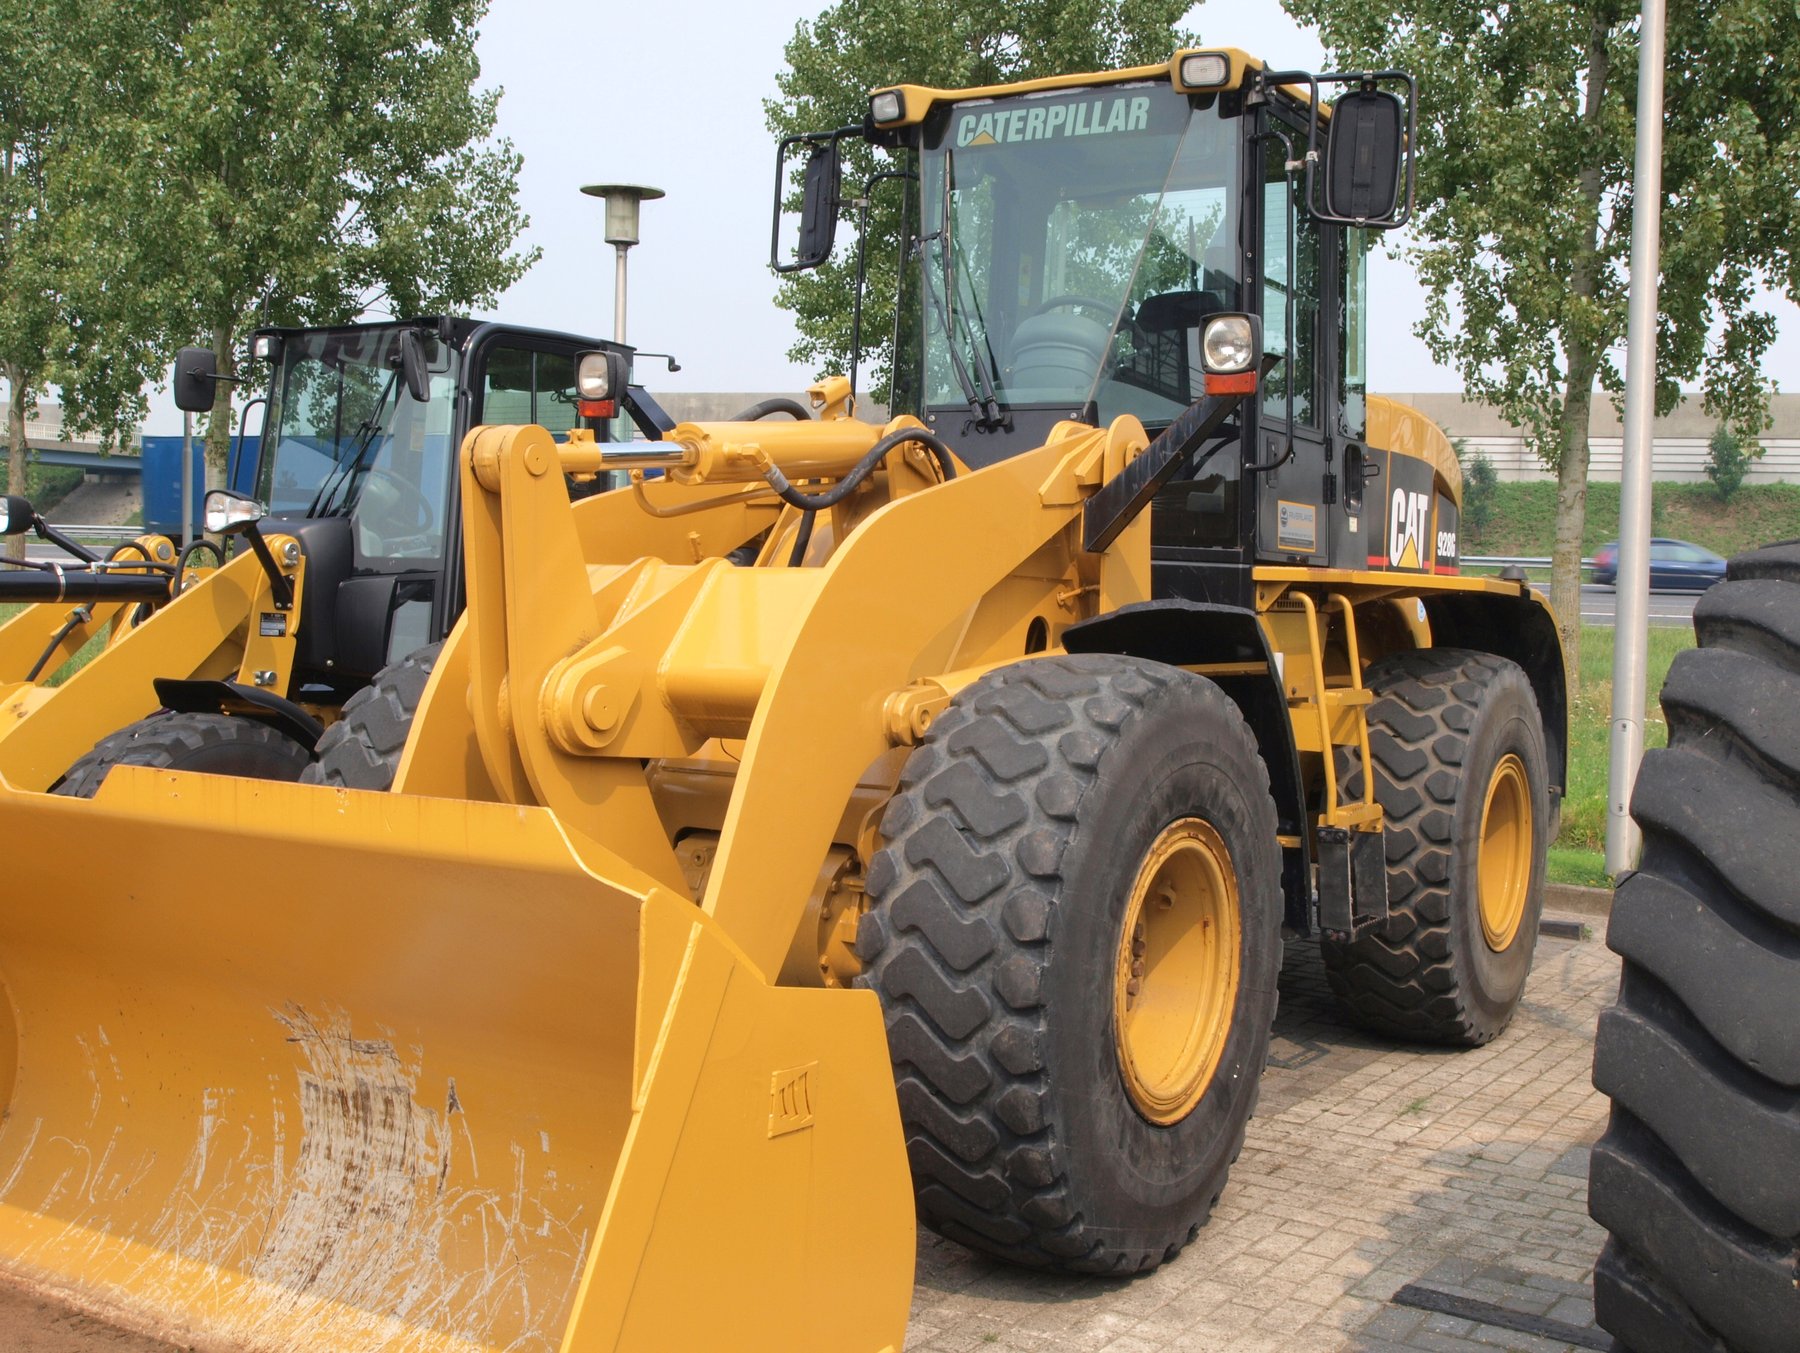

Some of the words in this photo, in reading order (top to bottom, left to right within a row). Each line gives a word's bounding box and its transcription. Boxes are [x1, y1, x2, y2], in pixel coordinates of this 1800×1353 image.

[957, 97, 1149, 147] CATERPILLAR
[1390, 488, 1428, 567] CAT
[1437, 531, 1455, 557] 928G
